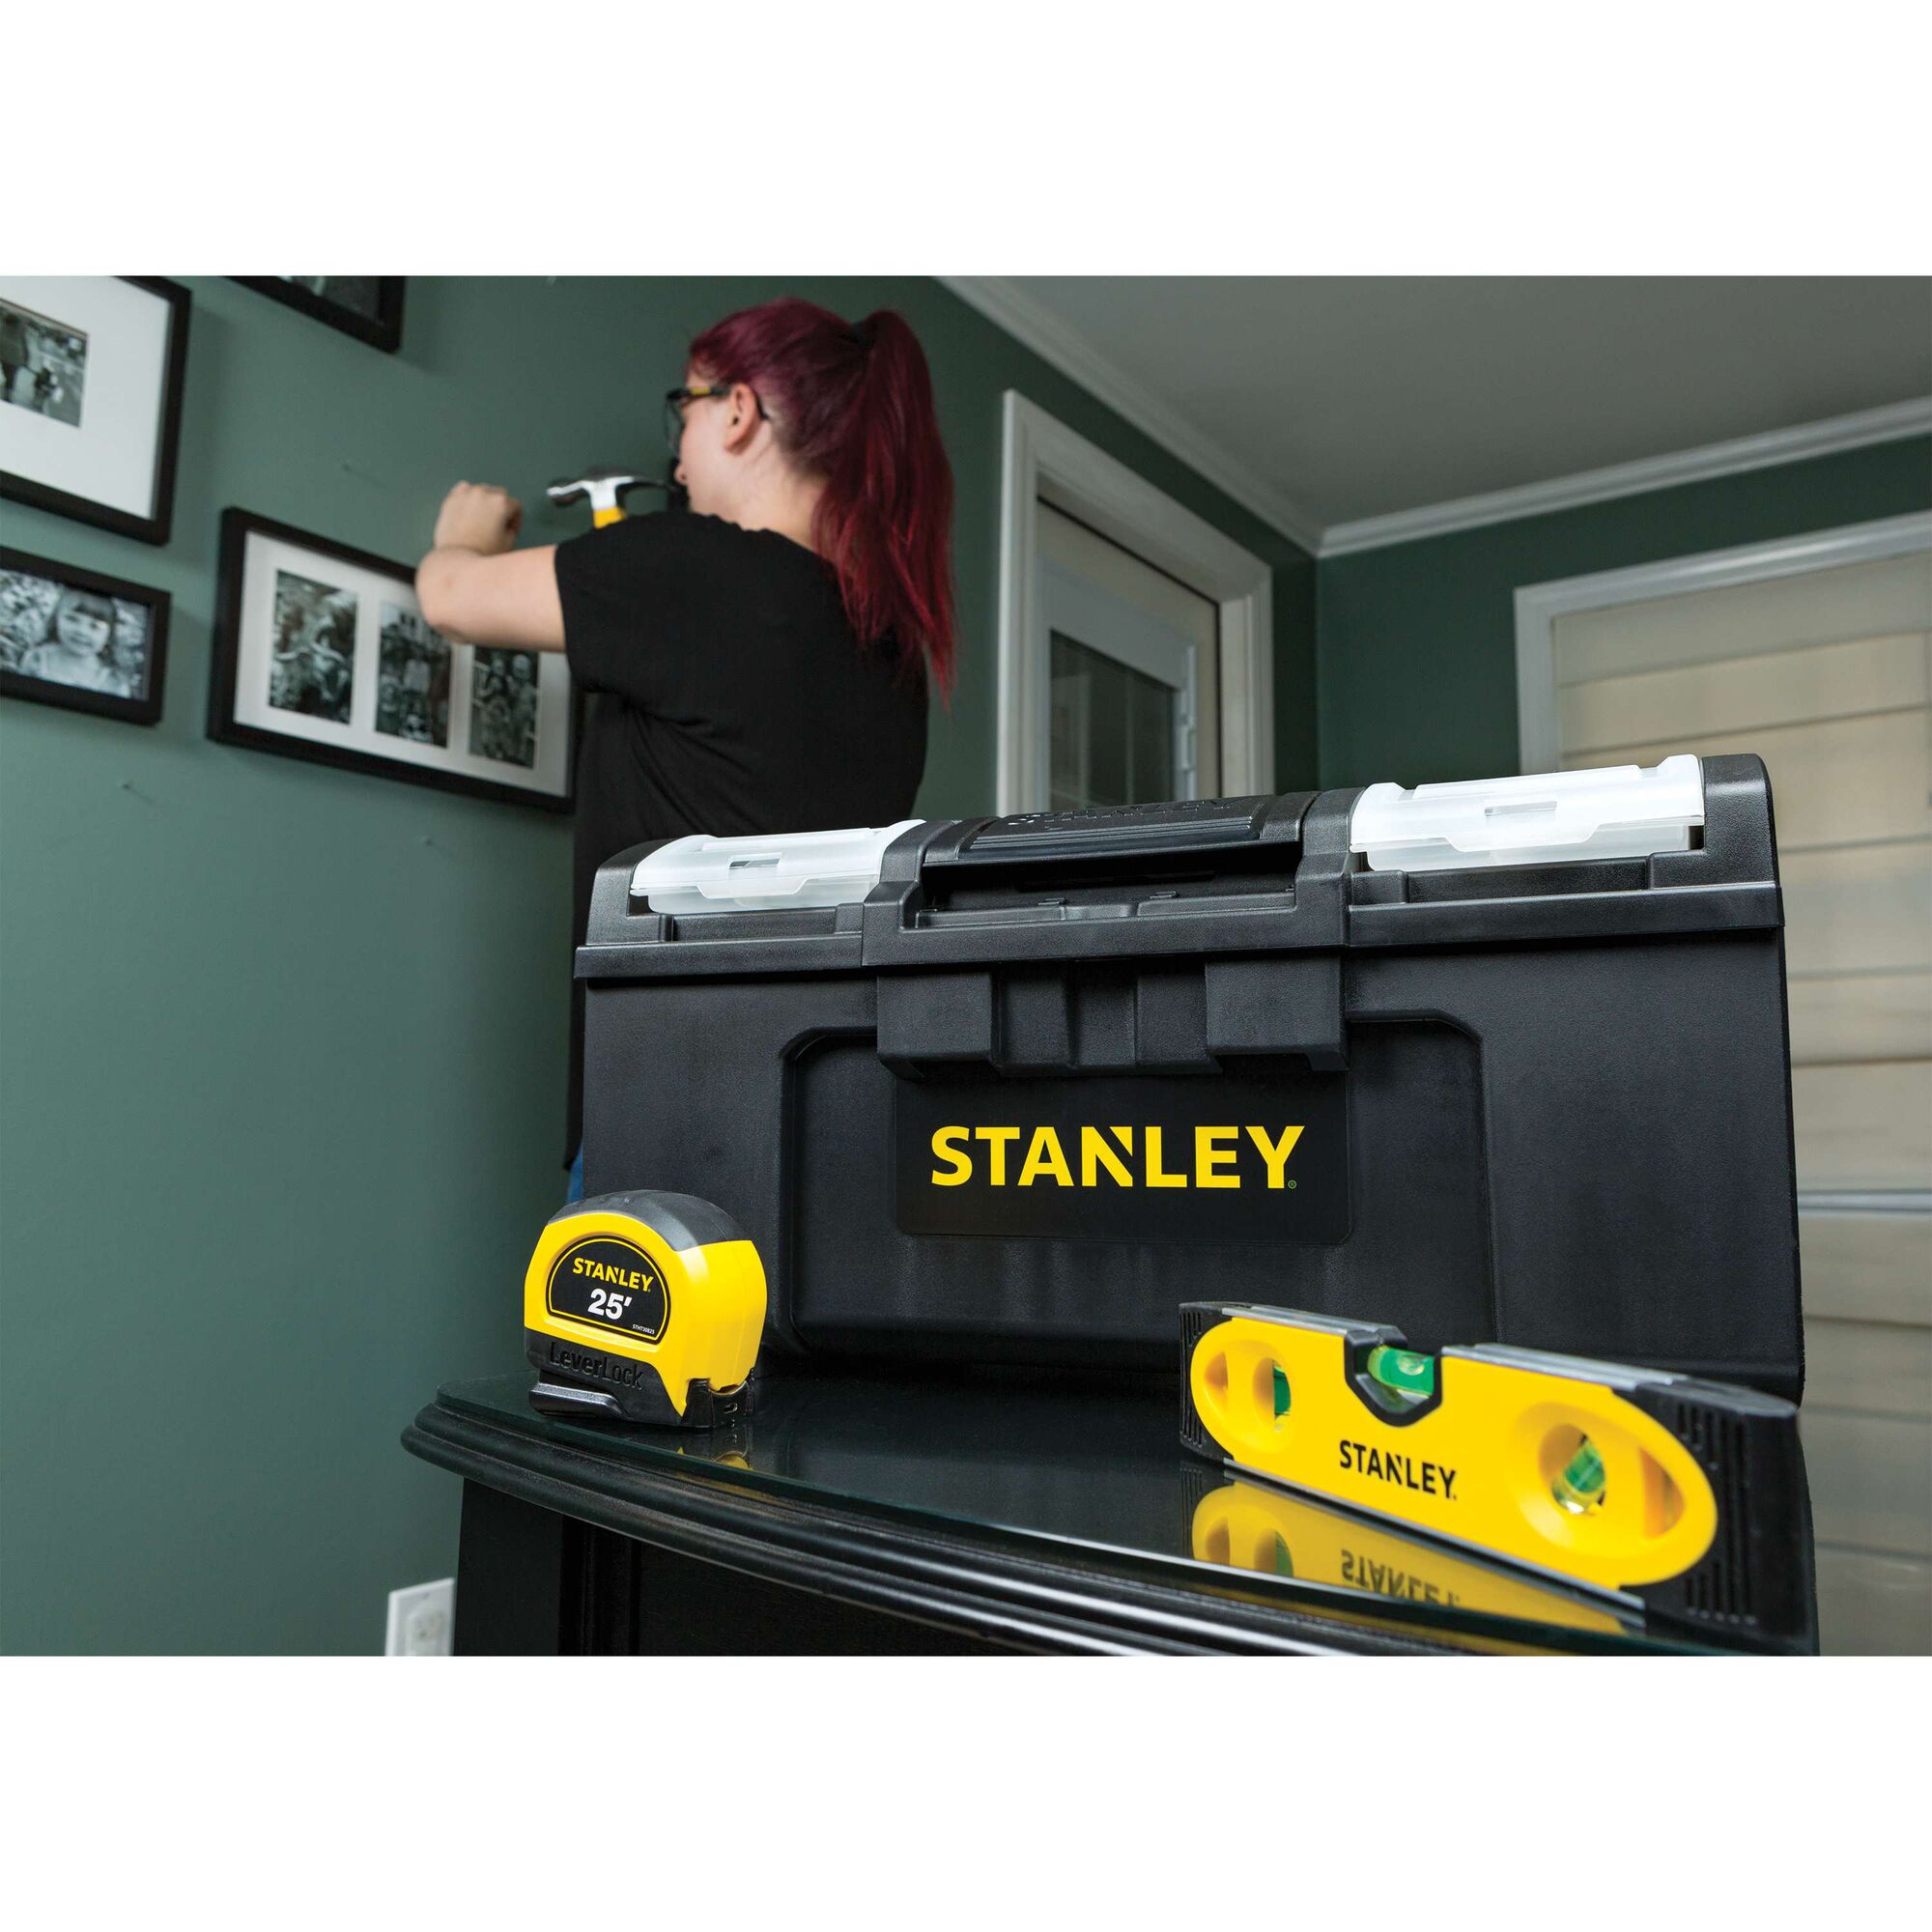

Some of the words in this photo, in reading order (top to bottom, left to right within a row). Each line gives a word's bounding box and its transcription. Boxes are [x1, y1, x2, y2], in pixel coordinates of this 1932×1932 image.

[931, 1125, 1305, 1189] STANLEY
[572, 1257, 654, 1293] STANLEY
[587, 1288, 633, 1321] 25'
[549, 1341, 644, 1390] LeverLock
[1339, 1439, 1457, 1499] STANLEY
